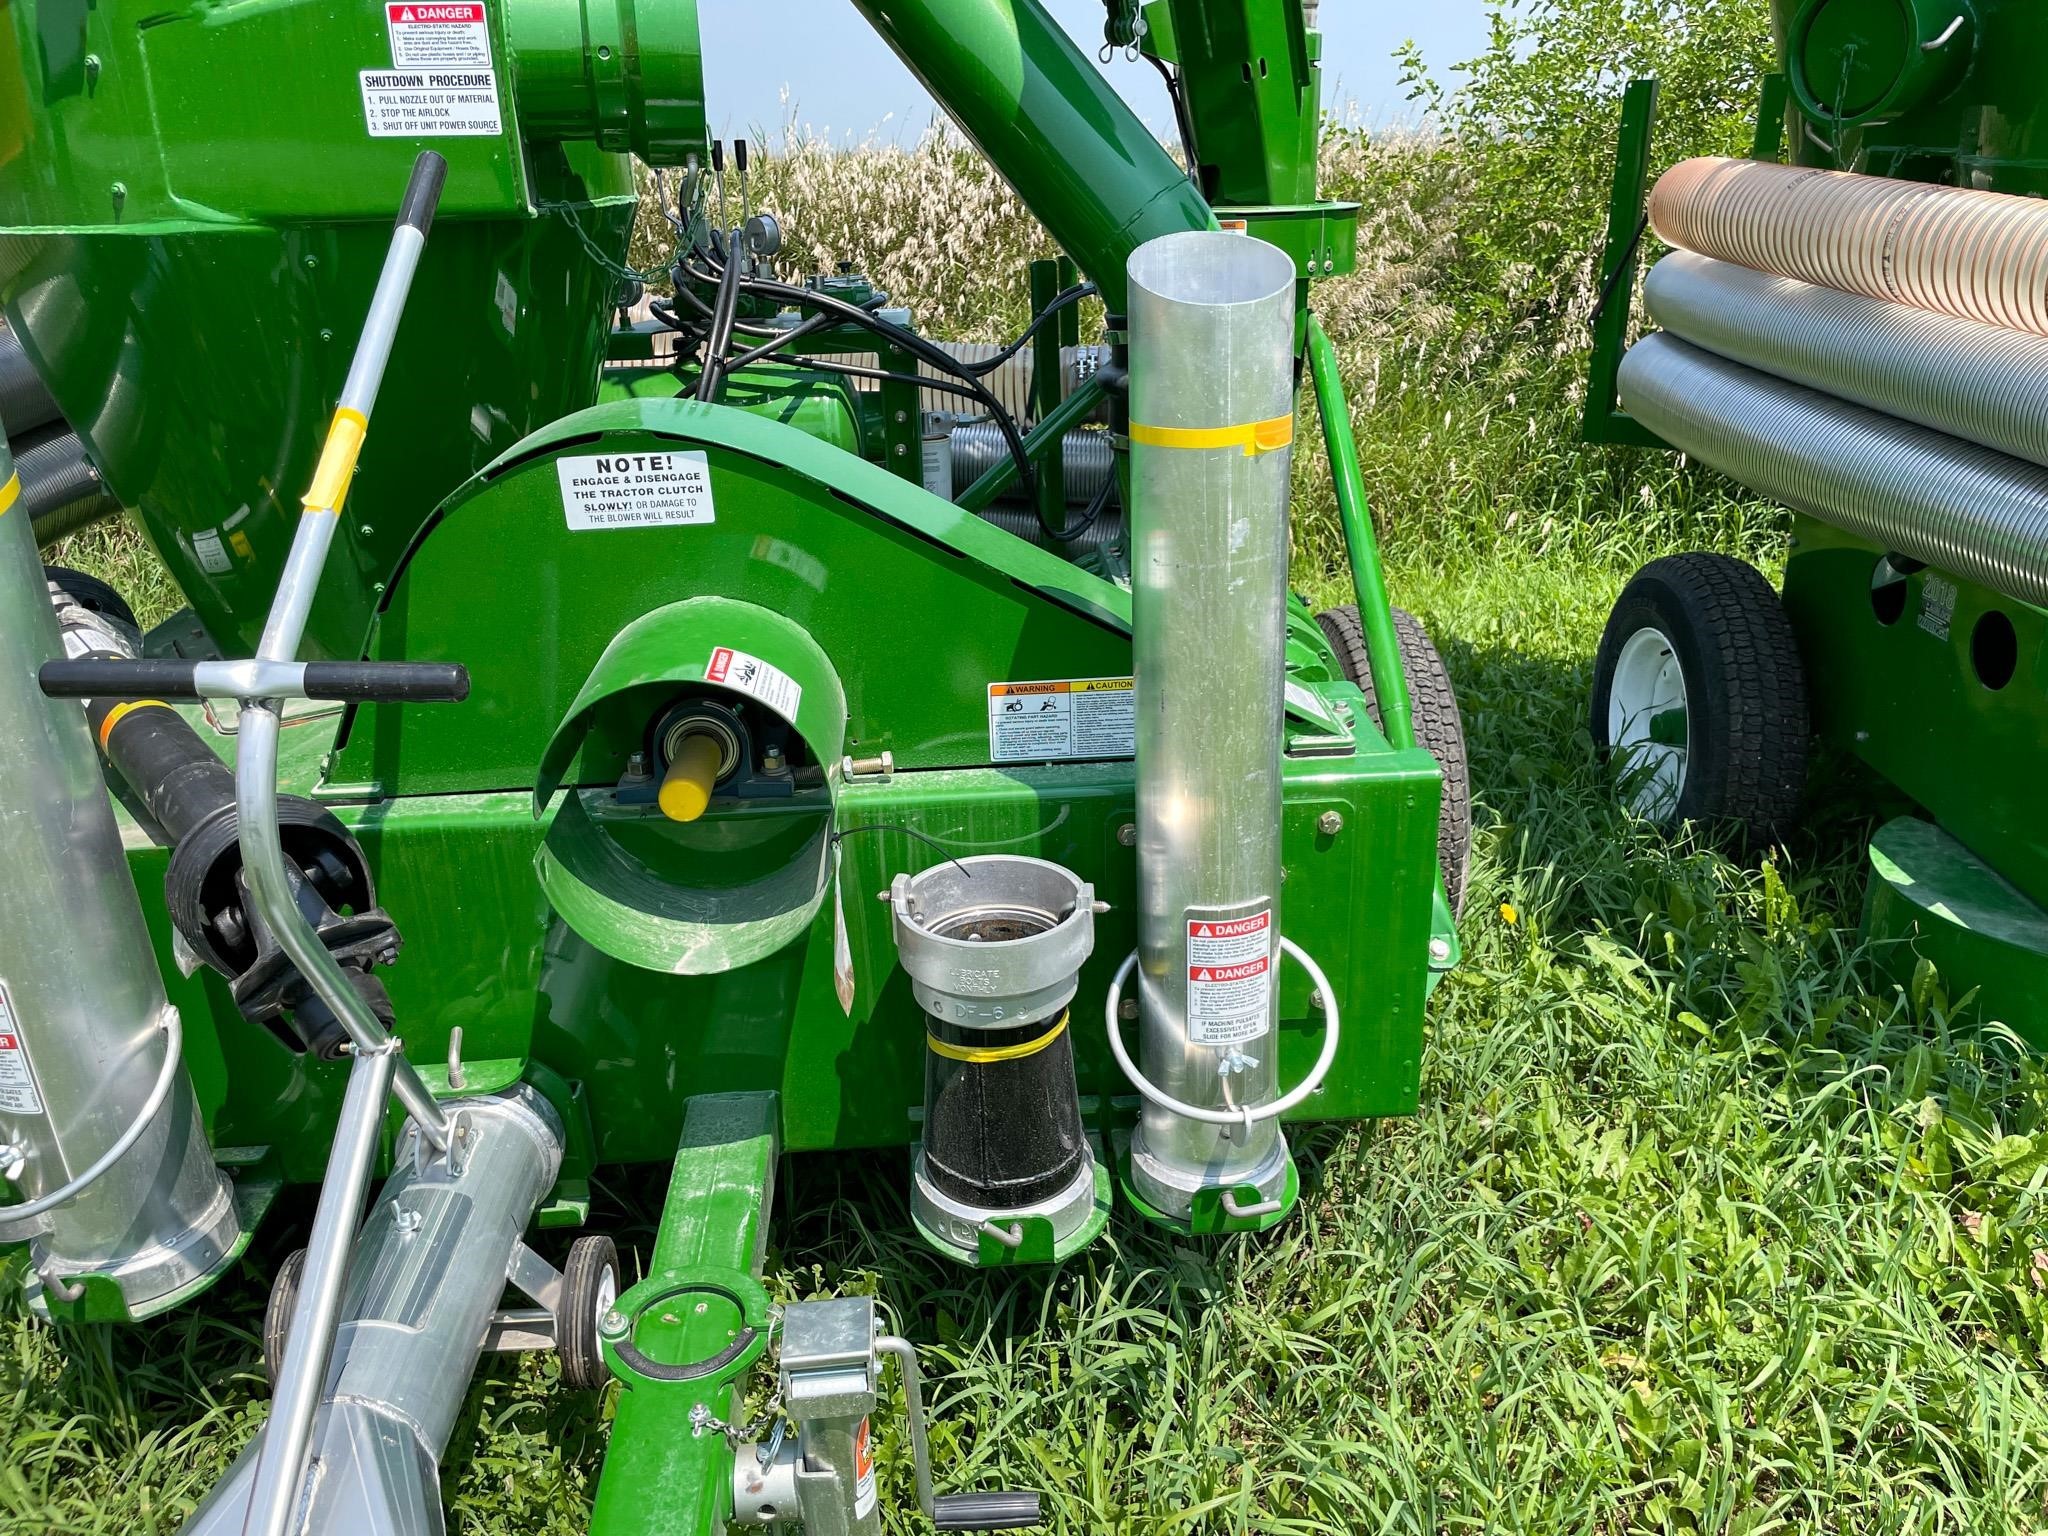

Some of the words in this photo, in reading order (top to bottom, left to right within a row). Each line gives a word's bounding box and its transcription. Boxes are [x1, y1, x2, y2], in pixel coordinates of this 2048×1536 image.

[418, 8, 473, 19] DANGER
[366, 75, 424, 87] SHUTDOWN
[429, 74, 491, 86] PROCEDURE
[379, 96, 398, 104] PULL
[400, 96, 428, 104] NOZZLE
[430, 95, 444, 104] OUT
[446, 95, 456, 103] OF
[458, 95, 494, 103] MATERIAL
[418, 108, 450, 117] AIRLOCK
[383, 122, 402, 130] SHUT
[421, 121, 437, 129] UNIT
[440, 121, 466, 129] POWER
[469, 121, 498, 129] SOURCE
[596, 456, 672, 473] NOTE!
[572, 477, 619, 486] ENGAGE
[636, 473, 700, 483] DISENGAGE
[574, 491, 596, 499] THE
[600, 488, 654, 498] TRACTOR
[658, 485, 703, 495] CLUTCH
[584, 502, 632, 512] SLOWLY!
[636, 501, 648, 509] OR
[650, 499, 684, 508] DAMAGE
[589, 514, 605, 523] THE
[607, 513, 641, 522] BLOWER
[644, 511, 663, 520] WILL
[666, 510, 695, 519] RESULT
[1015, 685, 1056, 693] WARNING
[1216, 917, 1264, 935] DANGER
[1216, 961, 1264, 979] DANGER
[1236, 1014, 1260, 1025] PULSATES
[1206, 1025, 1241, 1033] EXCESSIVELY
[1243, 1022, 1256, 1030] OPEN
